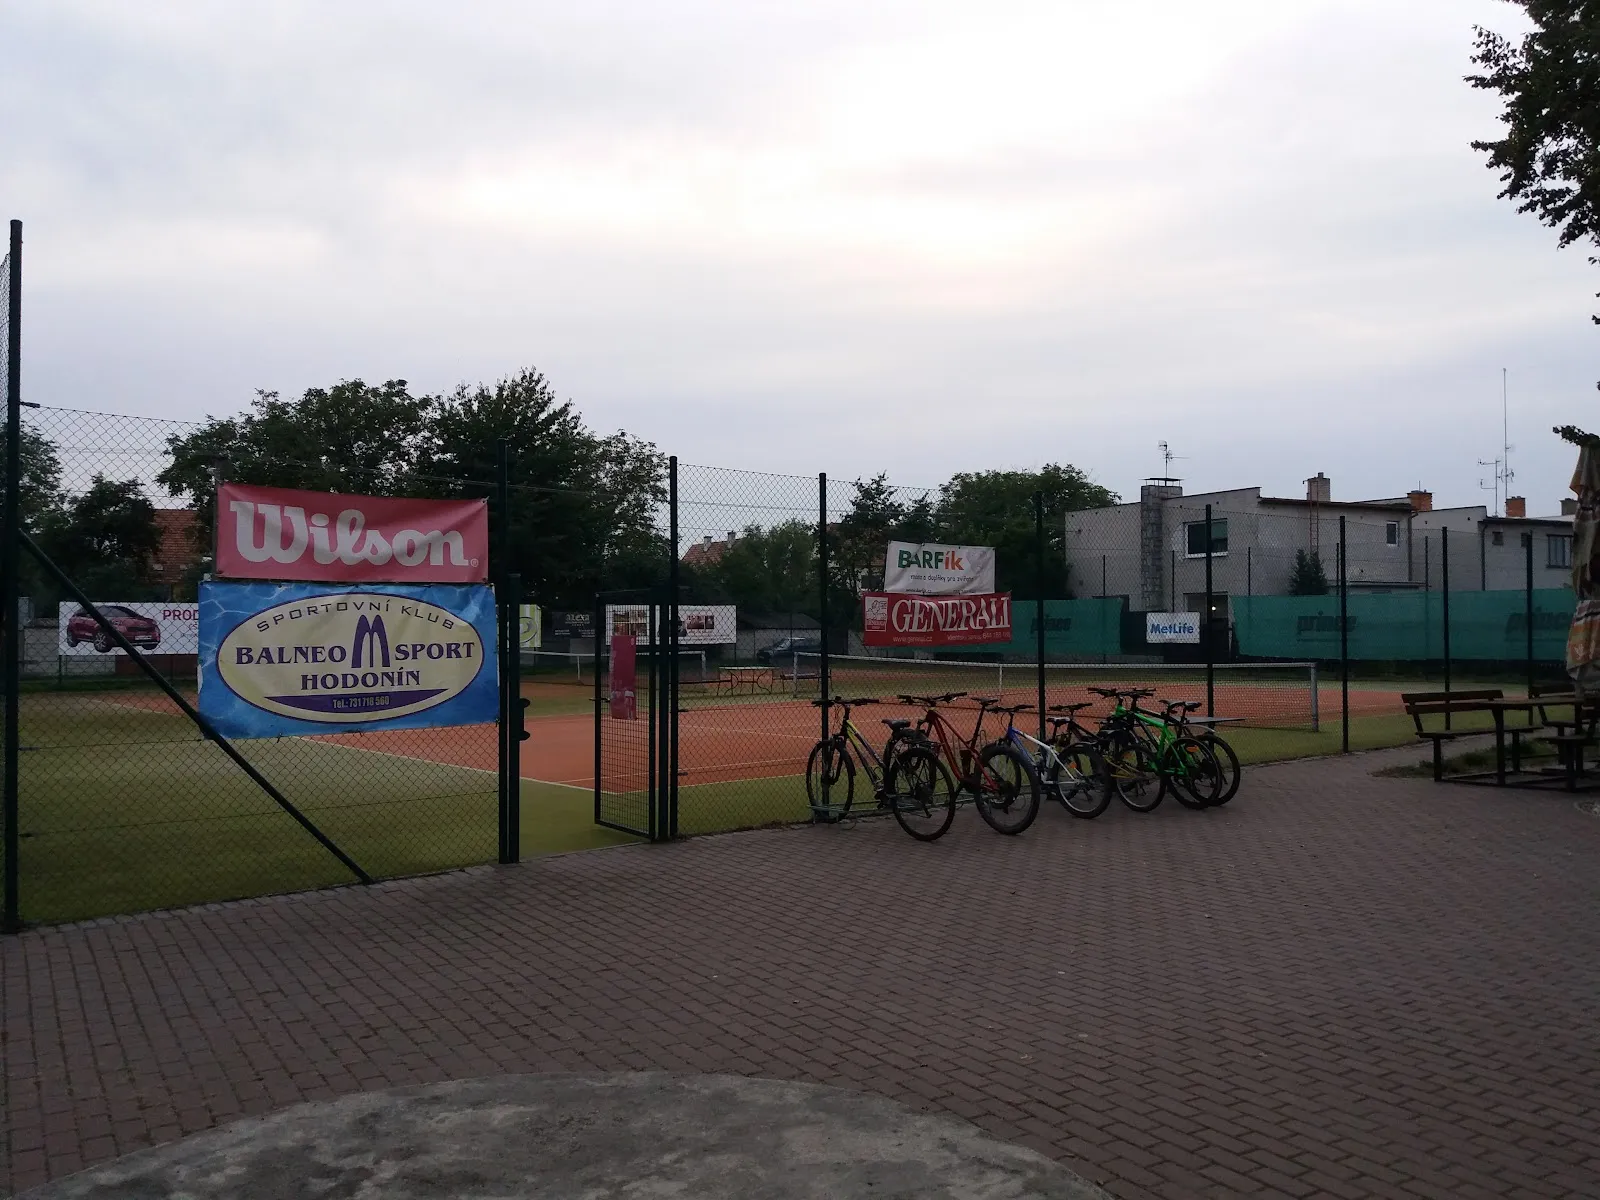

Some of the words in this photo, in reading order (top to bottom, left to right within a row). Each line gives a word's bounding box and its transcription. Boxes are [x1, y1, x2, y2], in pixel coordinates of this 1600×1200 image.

[229, 500, 469, 567] Wilson
[897, 549, 965, 571] BARFík
[256, 599, 391, 633] SPORTOVNÍ
[401, 605, 455, 631] KLUB
[891, 597, 1011, 633] GENERALI
[1150, 622, 1194, 635] MetLife
[235, 645, 347, 665] BALNEO
[394, 642, 475, 661] SPORT
[300, 667, 421, 690] HODONÍN
[349, 697, 361, 708] 731
